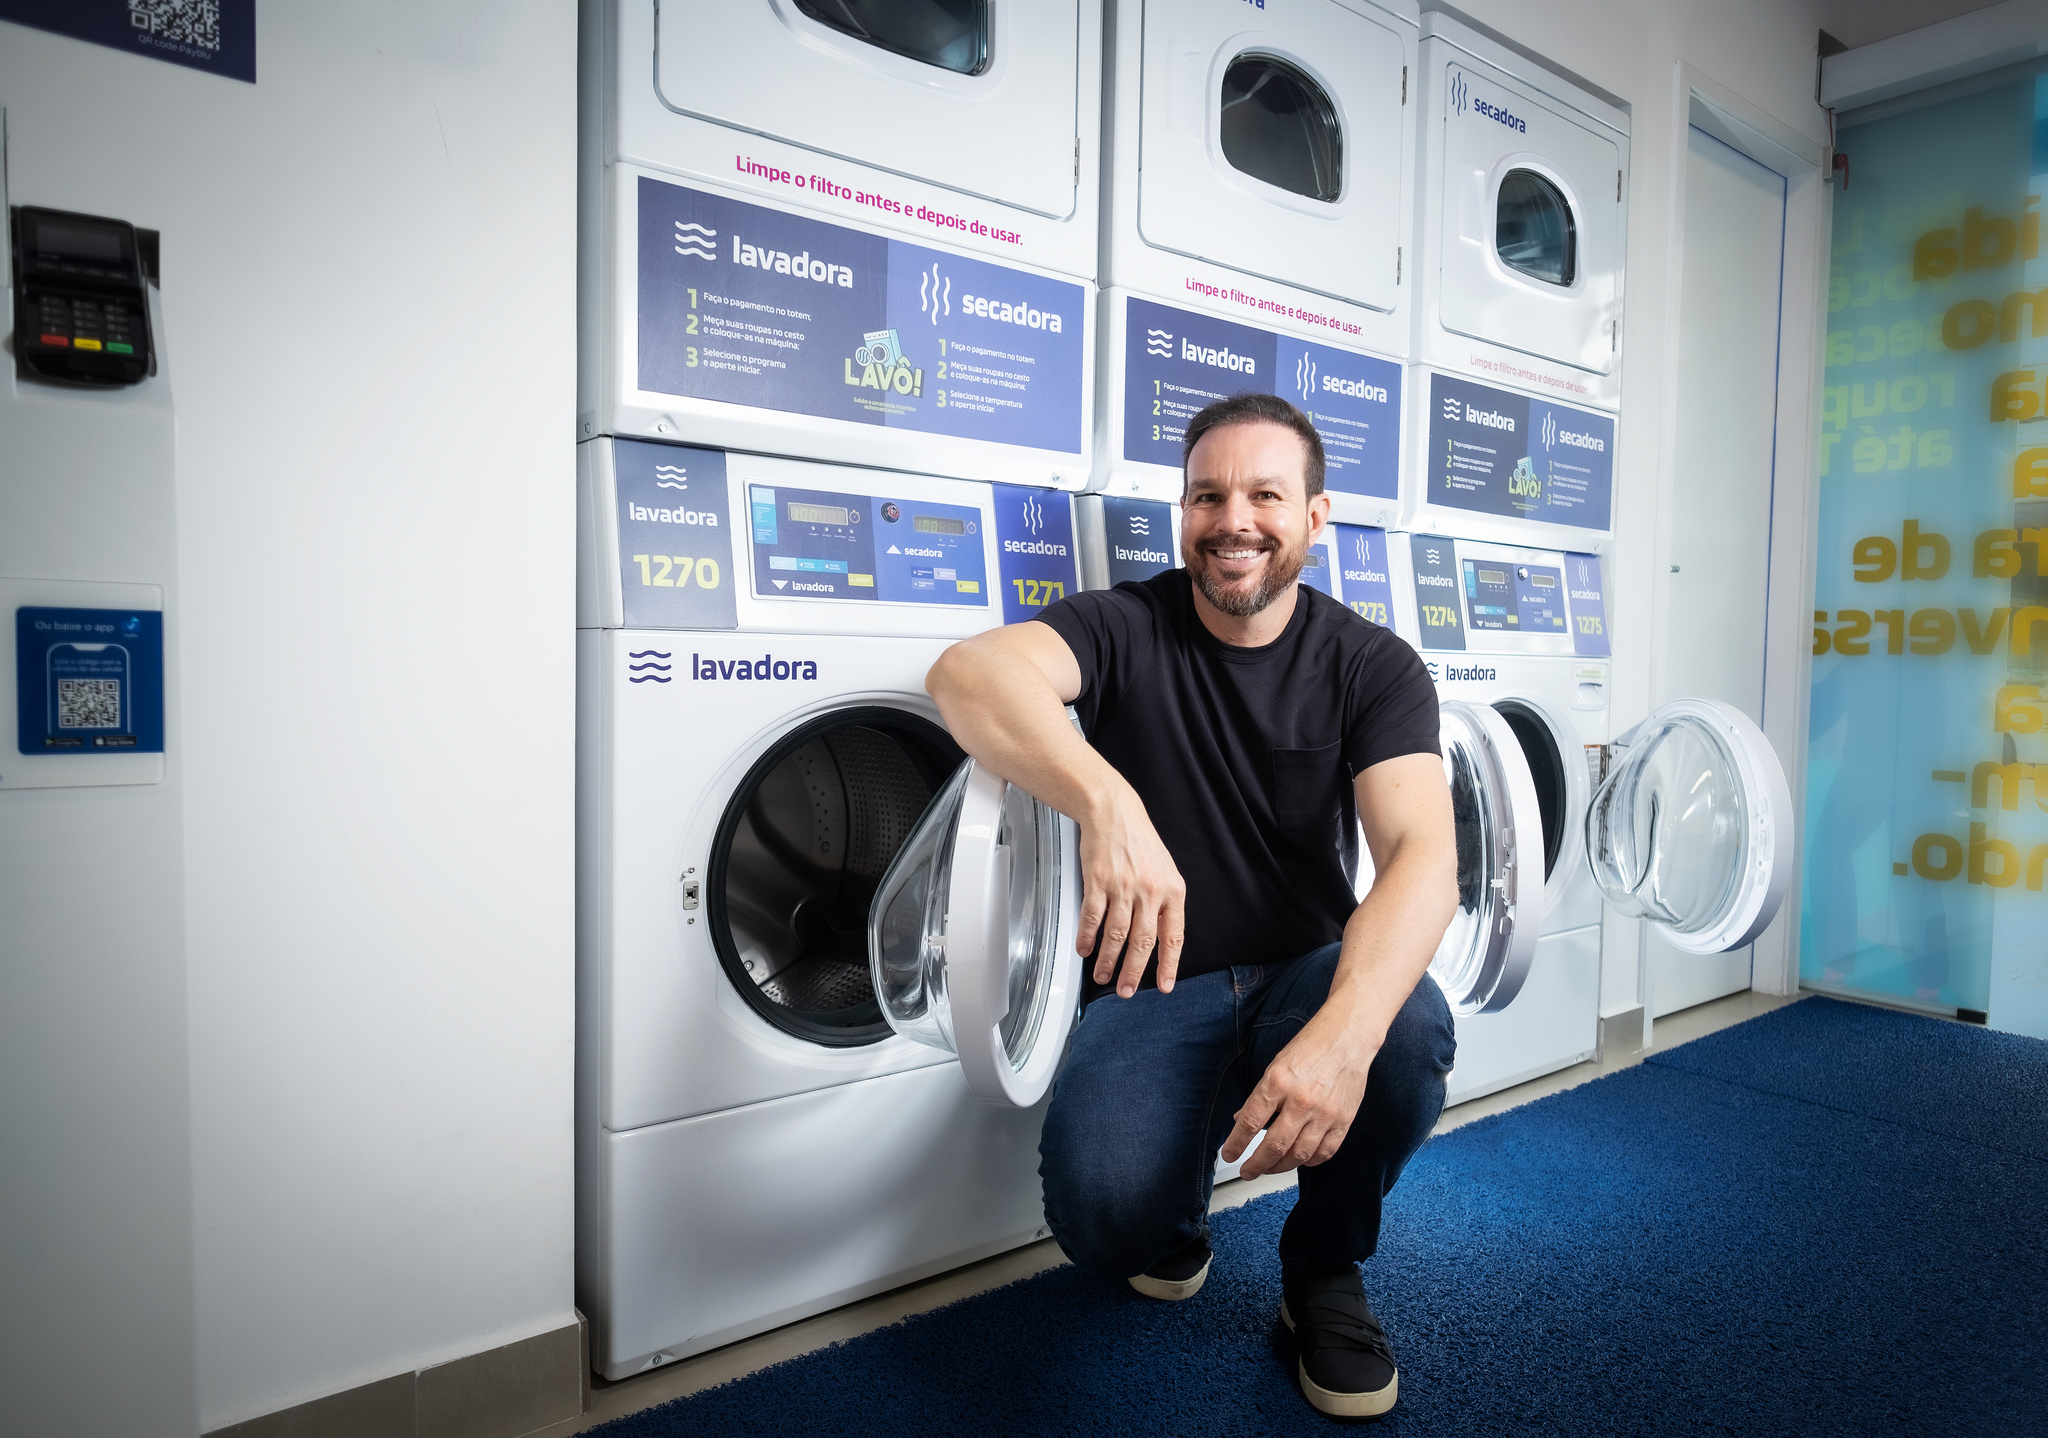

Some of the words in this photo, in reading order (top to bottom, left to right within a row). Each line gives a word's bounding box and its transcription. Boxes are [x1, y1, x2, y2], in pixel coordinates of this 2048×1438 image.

[154, 38, 178, 51] code
[1474, 98, 1526, 134] secadora
[736, 155, 791, 183] Limpe
[794, 175, 806, 187] o
[809, 175, 852, 200] filtro
[855, 191, 901, 213] antes
[904, 204, 913, 216] e
[916, 205, 967, 231] depois
[970, 220, 988, 236] de
[991, 227, 1024, 246] usar.
[733, 234, 853, 289] lavadora
[687, 288, 698, 309] 1
[703, 292, 722, 304] Faça
[730, 297, 774, 314] pagamento
[775, 307, 786, 316] no
[787, 308, 812, 322] totem;
[962, 294, 1062, 333] secadora
[1186, 277, 1219, 297] Limpe
[1221, 290, 1228, 299] o
[1230, 289, 1256, 307] filtro
[1258, 297, 1286, 315] antes
[1288, 306, 1294, 317] e
[1296, 307, 1328, 326] depois
[1329, 316, 1341, 329] de
[1342, 321, 1364, 336] usar.
[686, 314, 699, 335] 2
[703, 315, 724, 327] Meça
[725, 320, 744, 329] suas
[745, 323, 772, 335] roupas
[773, 327, 783, 336] no
[784, 329, 805, 341] cesto
[703, 326, 709, 334] e
[709, 327, 753, 343] coloque-as
[755, 335, 764, 344] na
[765, 336, 800, 351] máquina;
[938, 338, 946, 356] 1
[951, 341, 965, 352] Faça
[972, 347, 1007, 359] pagamento
[686, 346, 698, 368] 3
[703, 347, 741, 362] Selecione
[748, 355, 786, 369] programa
[1181, 337, 1256, 375] lavadora
[709, 361, 736, 371] aperte
[737, 363, 762, 375] iniciar.
[844, 355, 922, 398] LAVÔ!
[937, 361, 947, 379] 2
[951, 361, 967, 371] Meça
[968, 365, 982, 374] suas
[982, 368, 1004, 377] roupas
[1014, 373, 1030, 382] cesto
[1470, 355, 1492, 370] Limpe
[1494, 363, 1498, 371] o
[1499, 362, 1517, 376] filtro
[1518, 368, 1537, 381] antes
[1538, 373, 1542, 383] e
[1543, 374, 1564, 388] depois
[1565, 379, 1573, 391] de
[990, 378, 998, 386] na
[1153, 380, 1160, 396] 1
[1163, 382, 1176, 392] Faça
[1179, 386, 1206, 397] pagamento
[1322, 374, 1388, 404] secadora
[937, 390, 946, 408] 3
[950, 389, 979, 401] Selecione
[985, 396, 1023, 409] temperatura
[955, 401, 976, 410] aperte
[977, 403, 995, 413] iniciar.
[1152, 400, 1160, 416] 2
[1163, 399, 1176, 408] Meça
[1307, 411, 1312, 424] 1
[1466, 403, 1515, 433] lavadora
[1152, 425, 1160, 441] 3
[1559, 430, 1605, 453] secadora
[1447, 439, 1452, 452] 1
[1446, 455, 1452, 468] 2
[1446, 475, 1451, 488] 3
[1508, 473, 1542, 499] LAVÔ!
[1547, 474, 1552, 487] 2
[1547, 493, 1552, 505] 3
[629, 502, 718, 527] lavadora
[904, 547, 943, 558] secadora
[1004, 539, 1067, 557] secadora
[1115, 545, 1169, 564] lavadora
[633, 554, 720, 590] 1270
[1344, 569, 1386, 583] secadora
[1417, 572, 1454, 588] lavadora
[791, 580, 835, 593] lavadora
[1013, 579, 1065, 606] 1271
[1571, 589, 1601, 601] secadora
[1350, 601, 1388, 624] 1273
[1422, 605, 1457, 627] 1274
[1576, 615, 1603, 635] 1275
[692, 653, 818, 681] lavadora
[1446, 664, 1496, 681] lavadora
